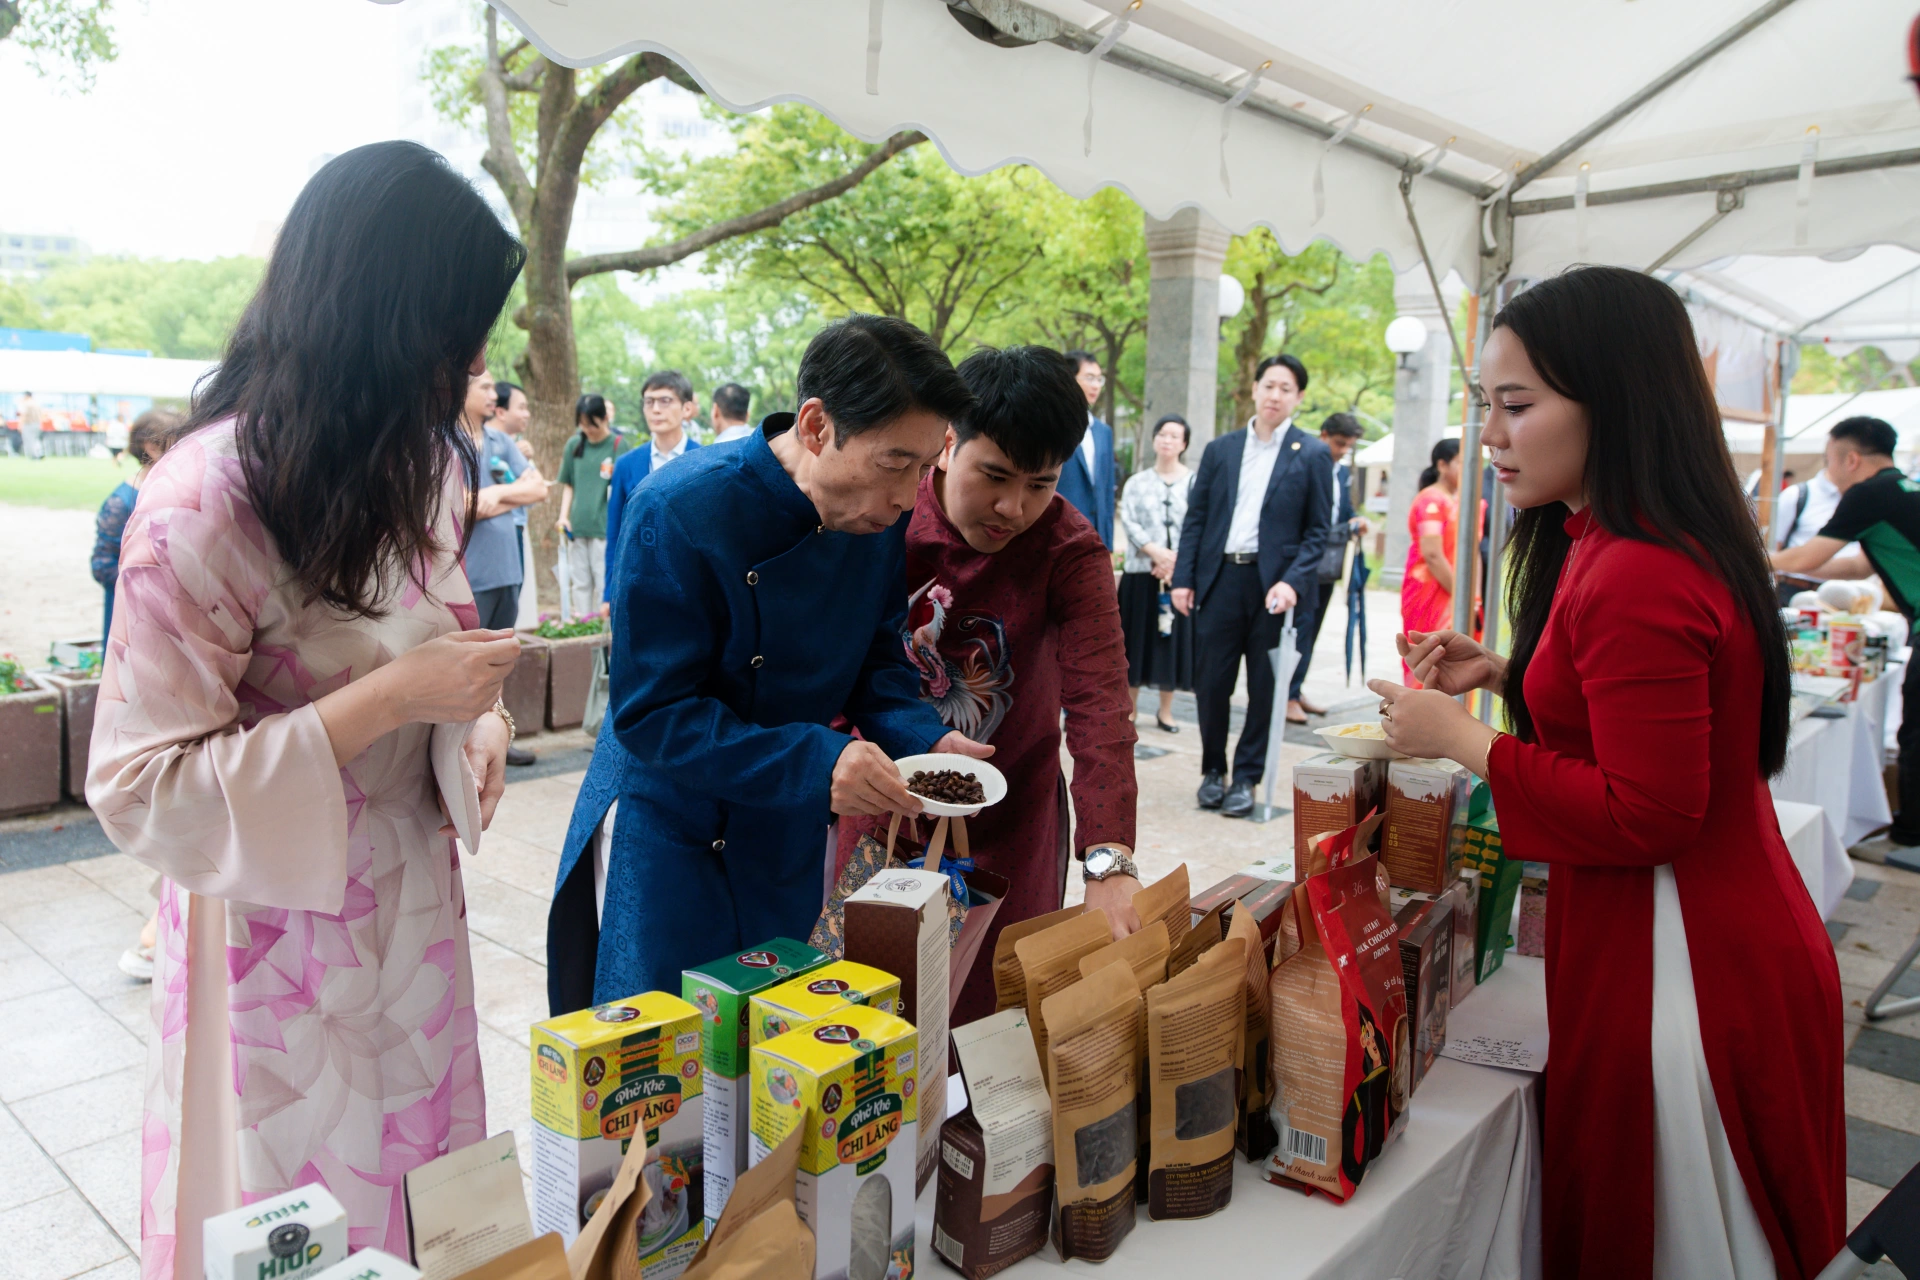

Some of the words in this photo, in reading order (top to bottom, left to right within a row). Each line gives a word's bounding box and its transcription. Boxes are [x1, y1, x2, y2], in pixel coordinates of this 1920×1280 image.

[1352, 880, 1363, 897] 36
[1356, 941, 1369, 955] MILK
[1373, 943, 1391, 960] DRINK
[615, 1082, 642, 1106] Phở
[643, 1079, 666, 1097] Khô
[605, 1112, 630, 1134] CHI
[850, 1104, 873, 1129] Phở
[873, 1099, 891, 1117] Khô
[842, 1136, 864, 1159] CHI
[866, 1116, 897, 1146] LĂNG
[1293, 1165, 1315, 1179] thanh
[1317, 1174, 1338, 1183] xuân
